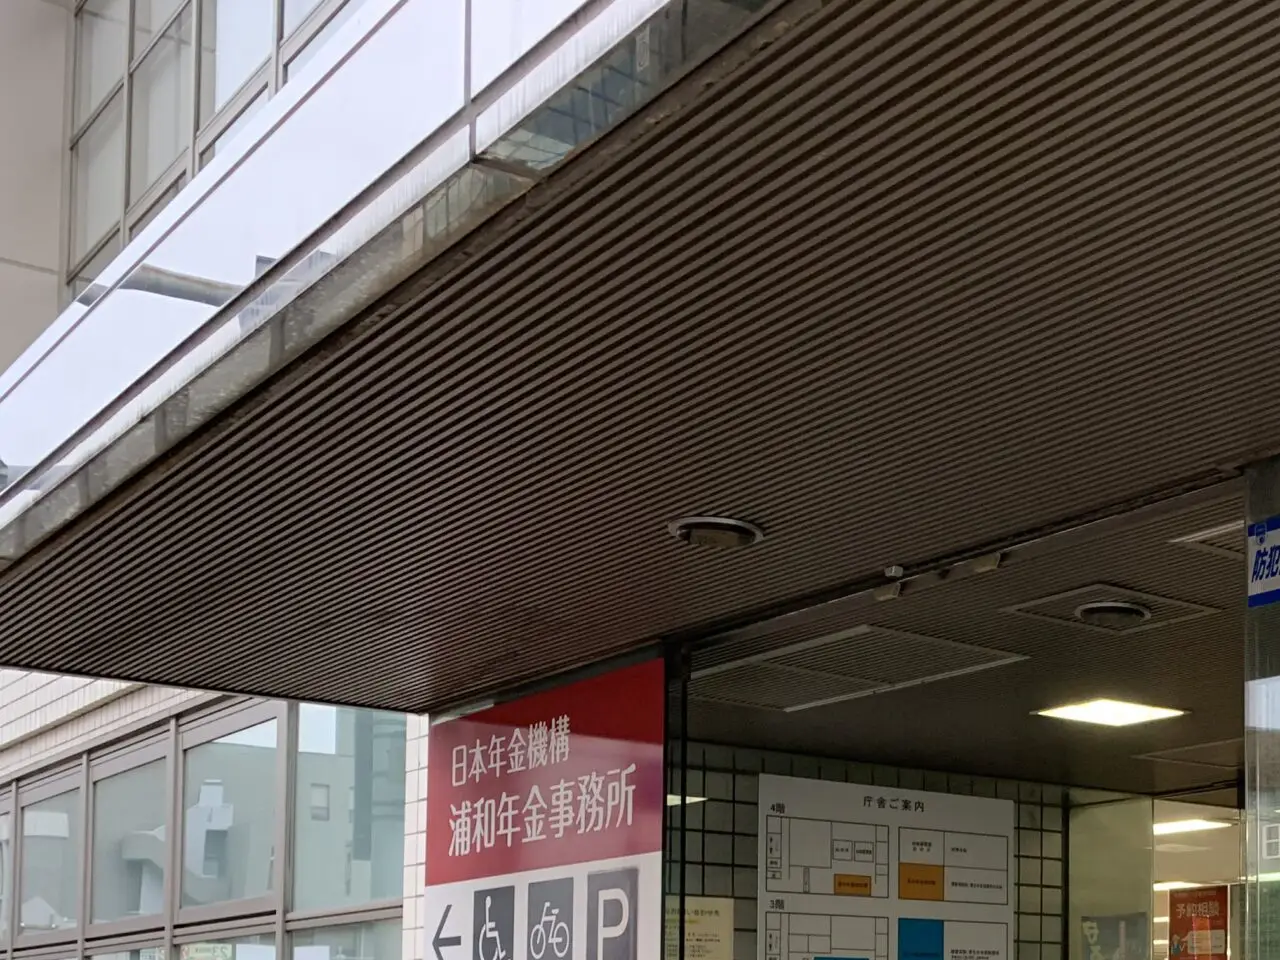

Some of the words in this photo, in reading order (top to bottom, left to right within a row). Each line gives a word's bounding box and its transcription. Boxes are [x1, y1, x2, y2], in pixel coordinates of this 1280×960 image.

[451, 714, 570, 787] 日本年金機構
[448, 763, 636, 856] 浦和年金事務所
